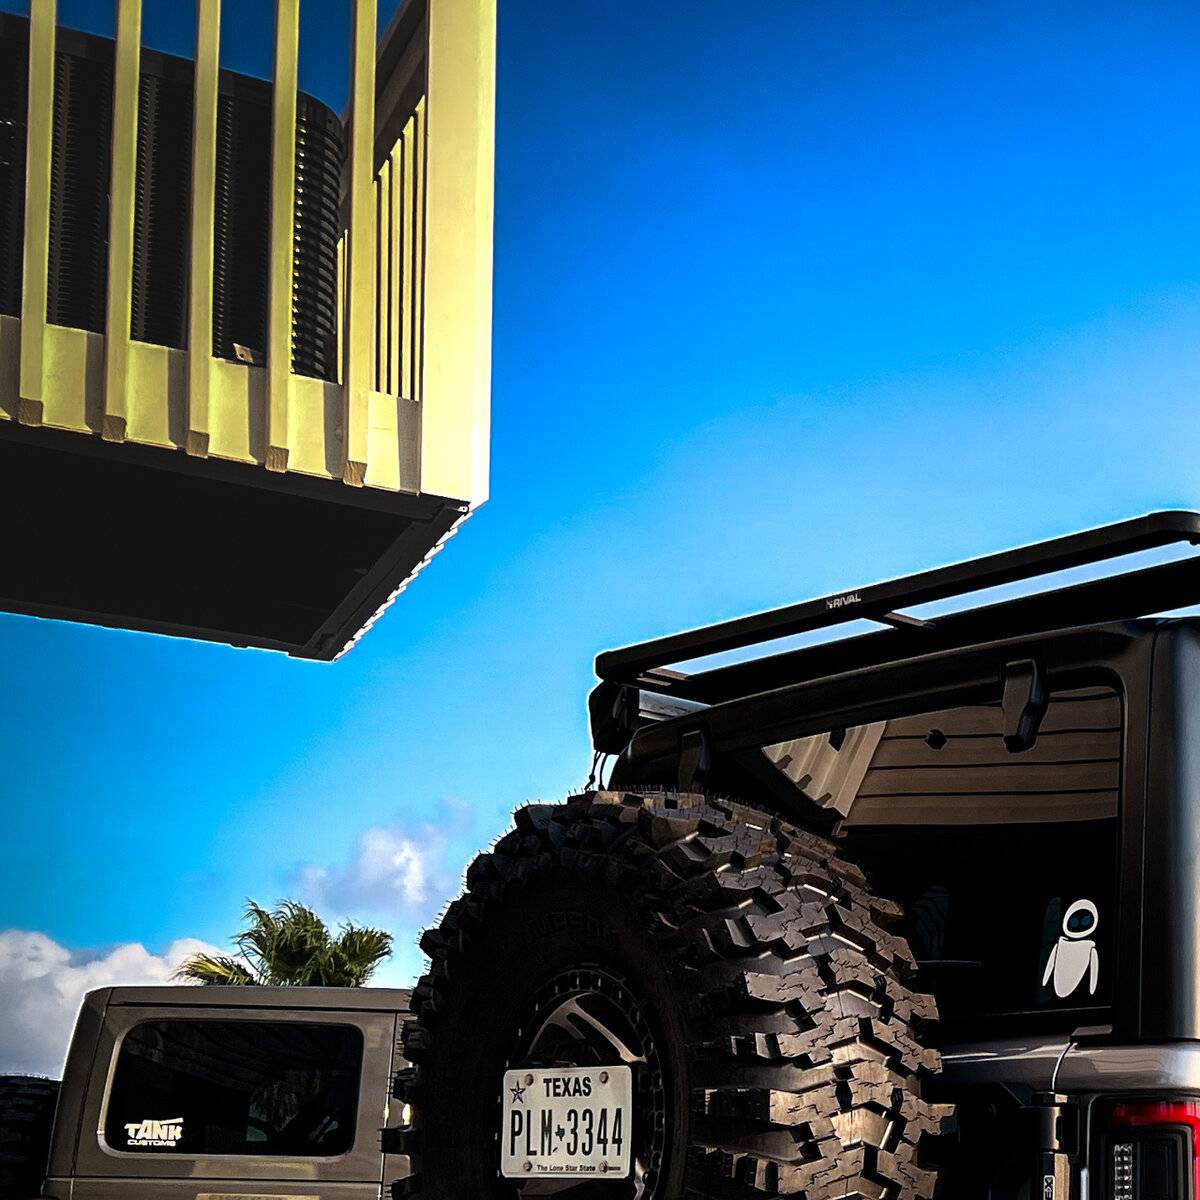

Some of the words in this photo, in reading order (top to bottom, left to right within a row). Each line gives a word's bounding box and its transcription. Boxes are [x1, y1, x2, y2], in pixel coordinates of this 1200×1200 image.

[543, 1076, 592, 1098] TEXAS
[124, 1117, 184, 1140] TANK
[537, 1164, 548, 1172] The
[549, 1164, 564, 1172] Lone
[565, 1164, 578, 1172] Star
[579, 1164, 596, 1172] State
